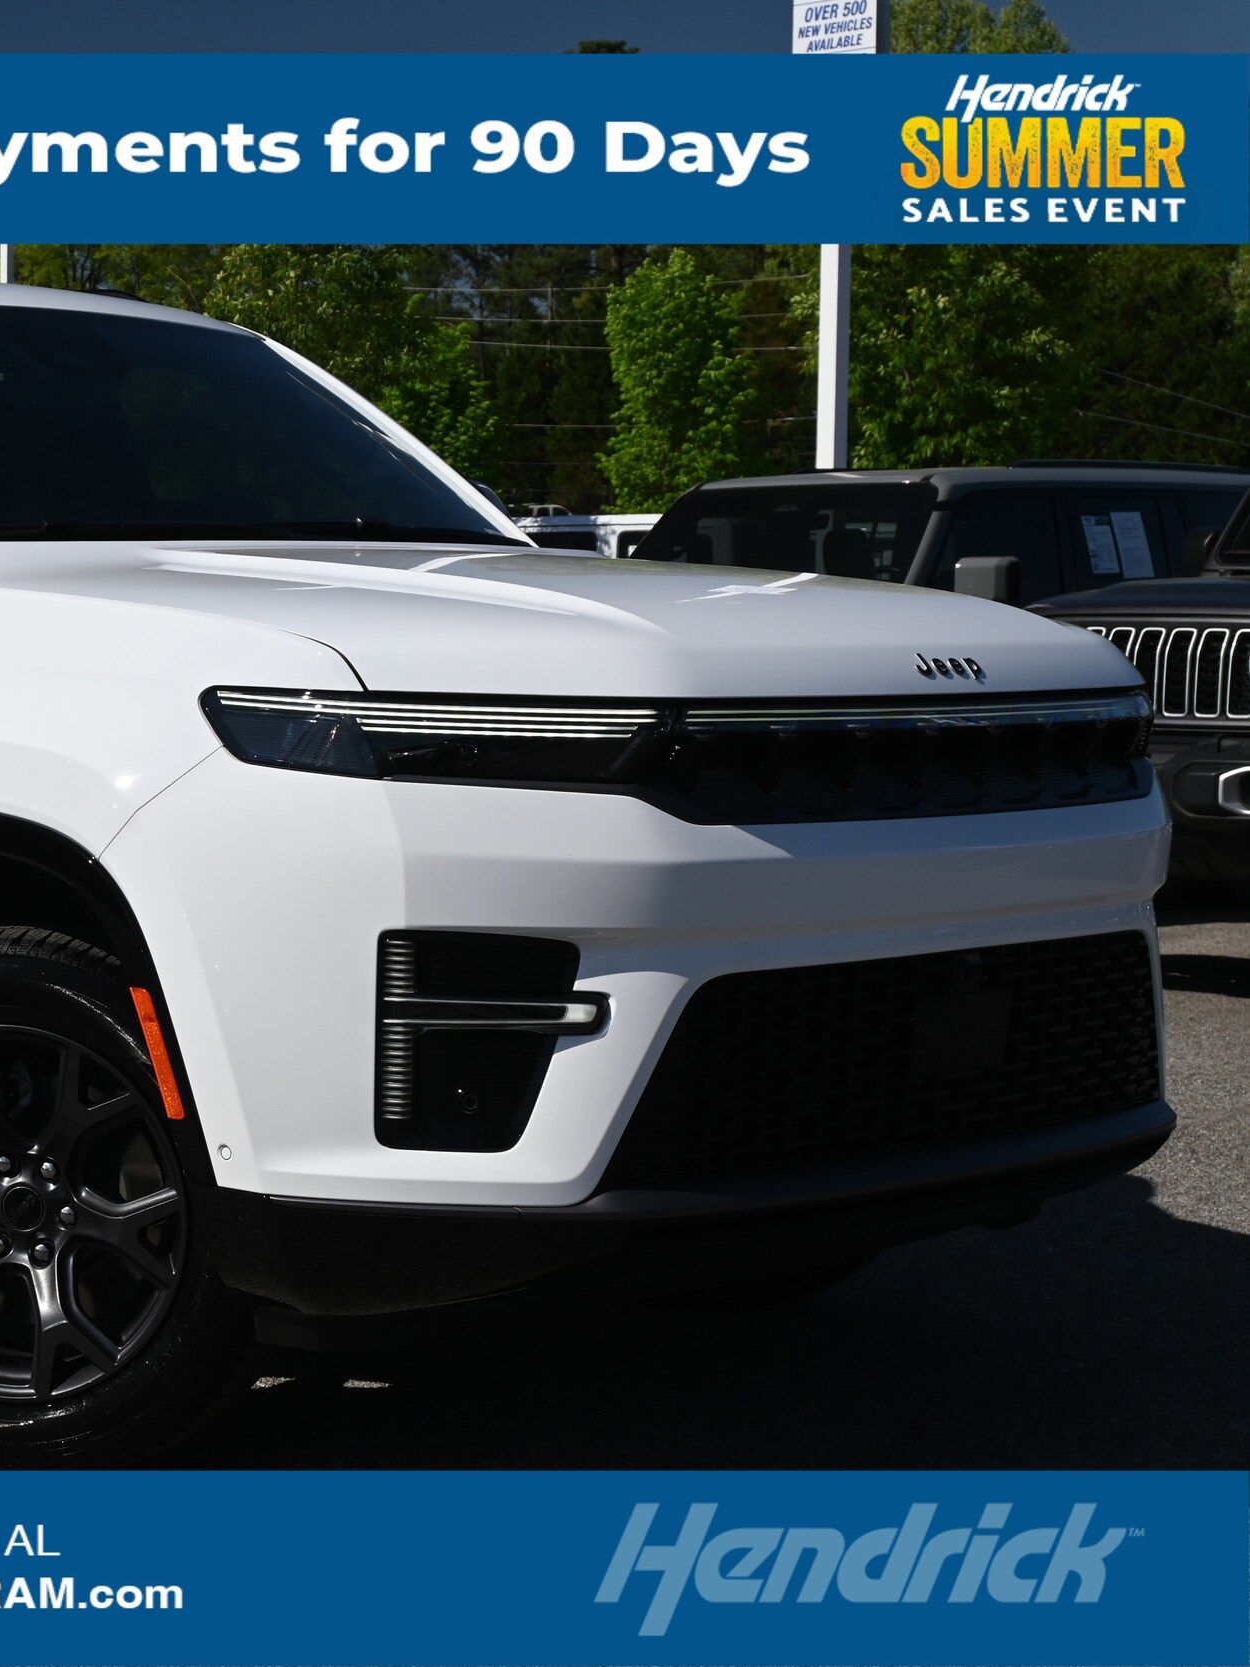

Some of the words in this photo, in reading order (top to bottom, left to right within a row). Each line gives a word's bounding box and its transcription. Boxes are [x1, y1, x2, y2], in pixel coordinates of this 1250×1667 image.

[805, 3, 839, 23] OVER
[842, 0, 867, 17] 500
[797, 24, 821, 39] NEW
[824, 16, 873, 36] VEHICLES
[806, 33, 864, 53] AVAILABLE
[914, 652, 983, 682] Jeep
